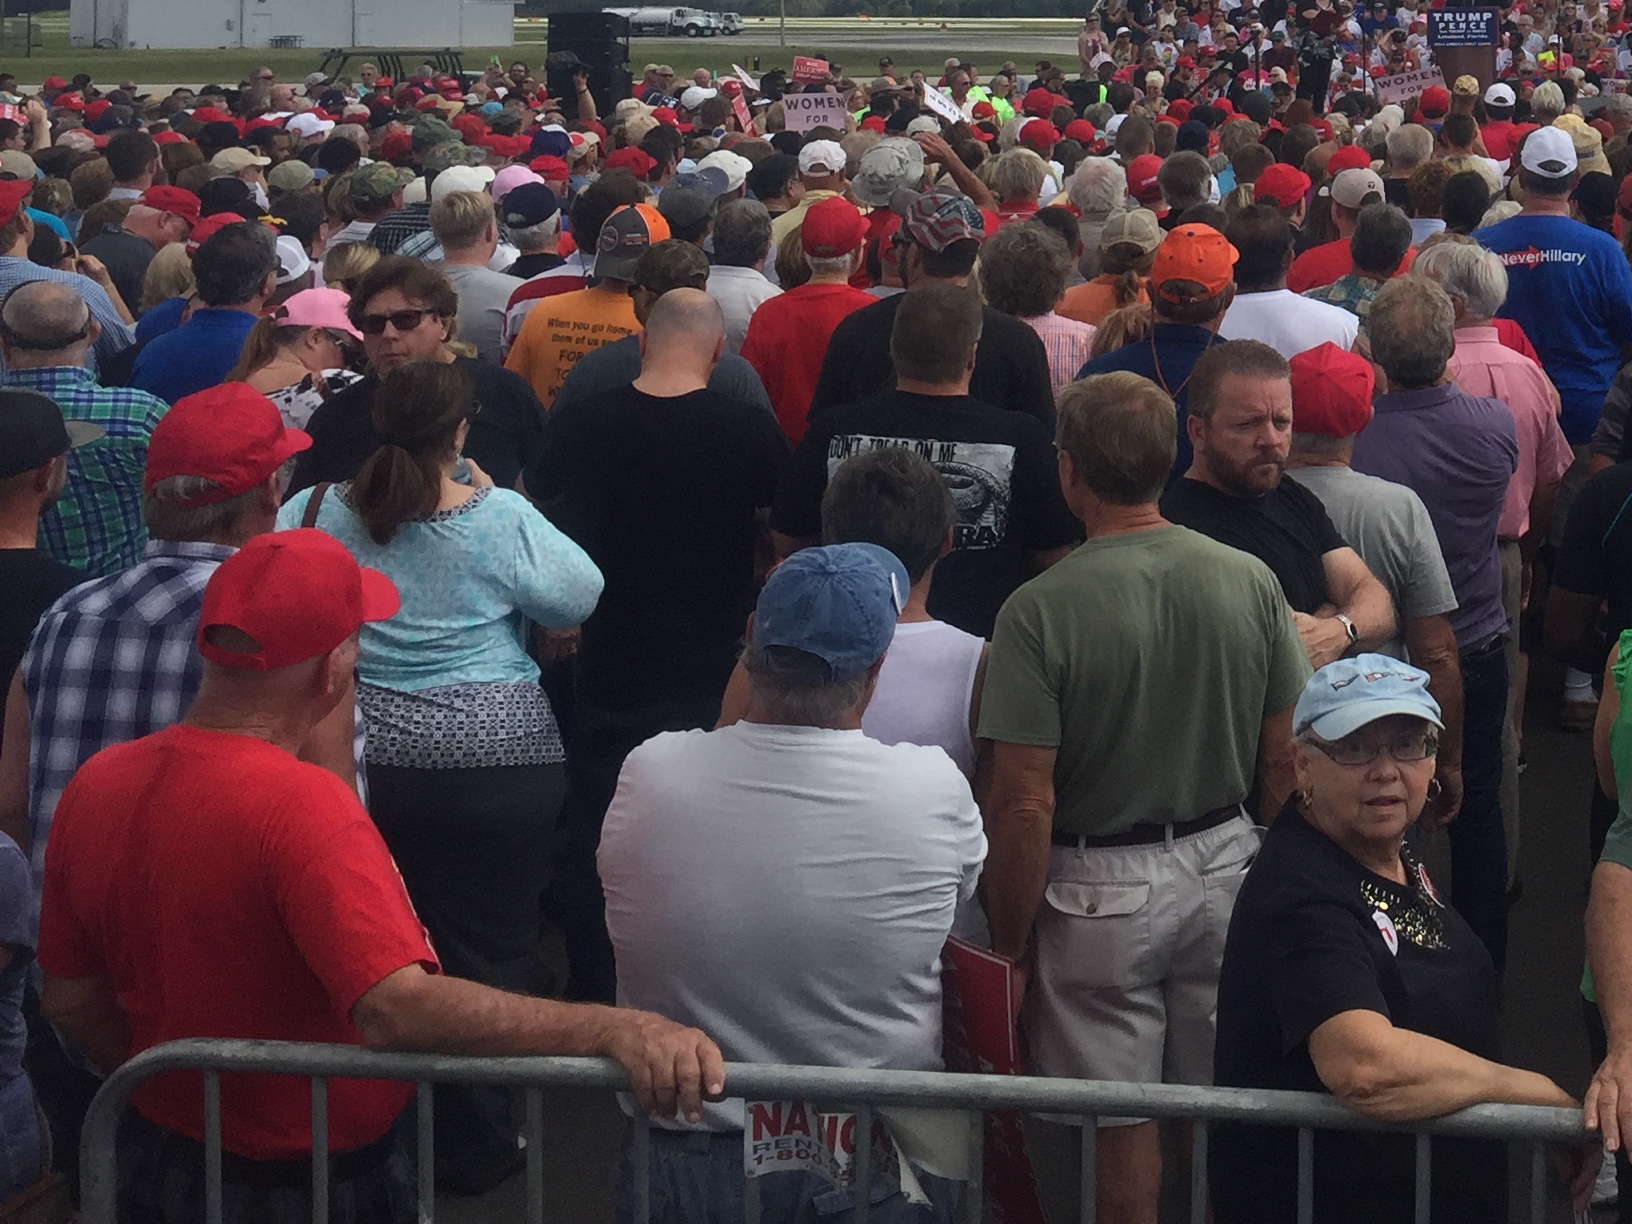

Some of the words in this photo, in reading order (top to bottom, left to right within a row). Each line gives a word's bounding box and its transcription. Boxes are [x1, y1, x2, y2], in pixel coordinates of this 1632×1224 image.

[1433, 12, 1492, 22] TRUMP
[1438, 22, 1487, 30] PENCE
[1377, 69, 1442, 89] WOMEN
[1400, 84, 1423, 95] FOR
[785, 97, 845, 110] WOMEN
[805, 115, 829, 123] FOR
[547, 317, 571, 329] When
[571, 320, 590, 332] you
[591, 324, 605, 334] go
[575, 335, 586, 345] of
[587, 338, 599, 347] us
[829, 435, 863, 460] DON'T
[914, 440, 934, 462] ON
